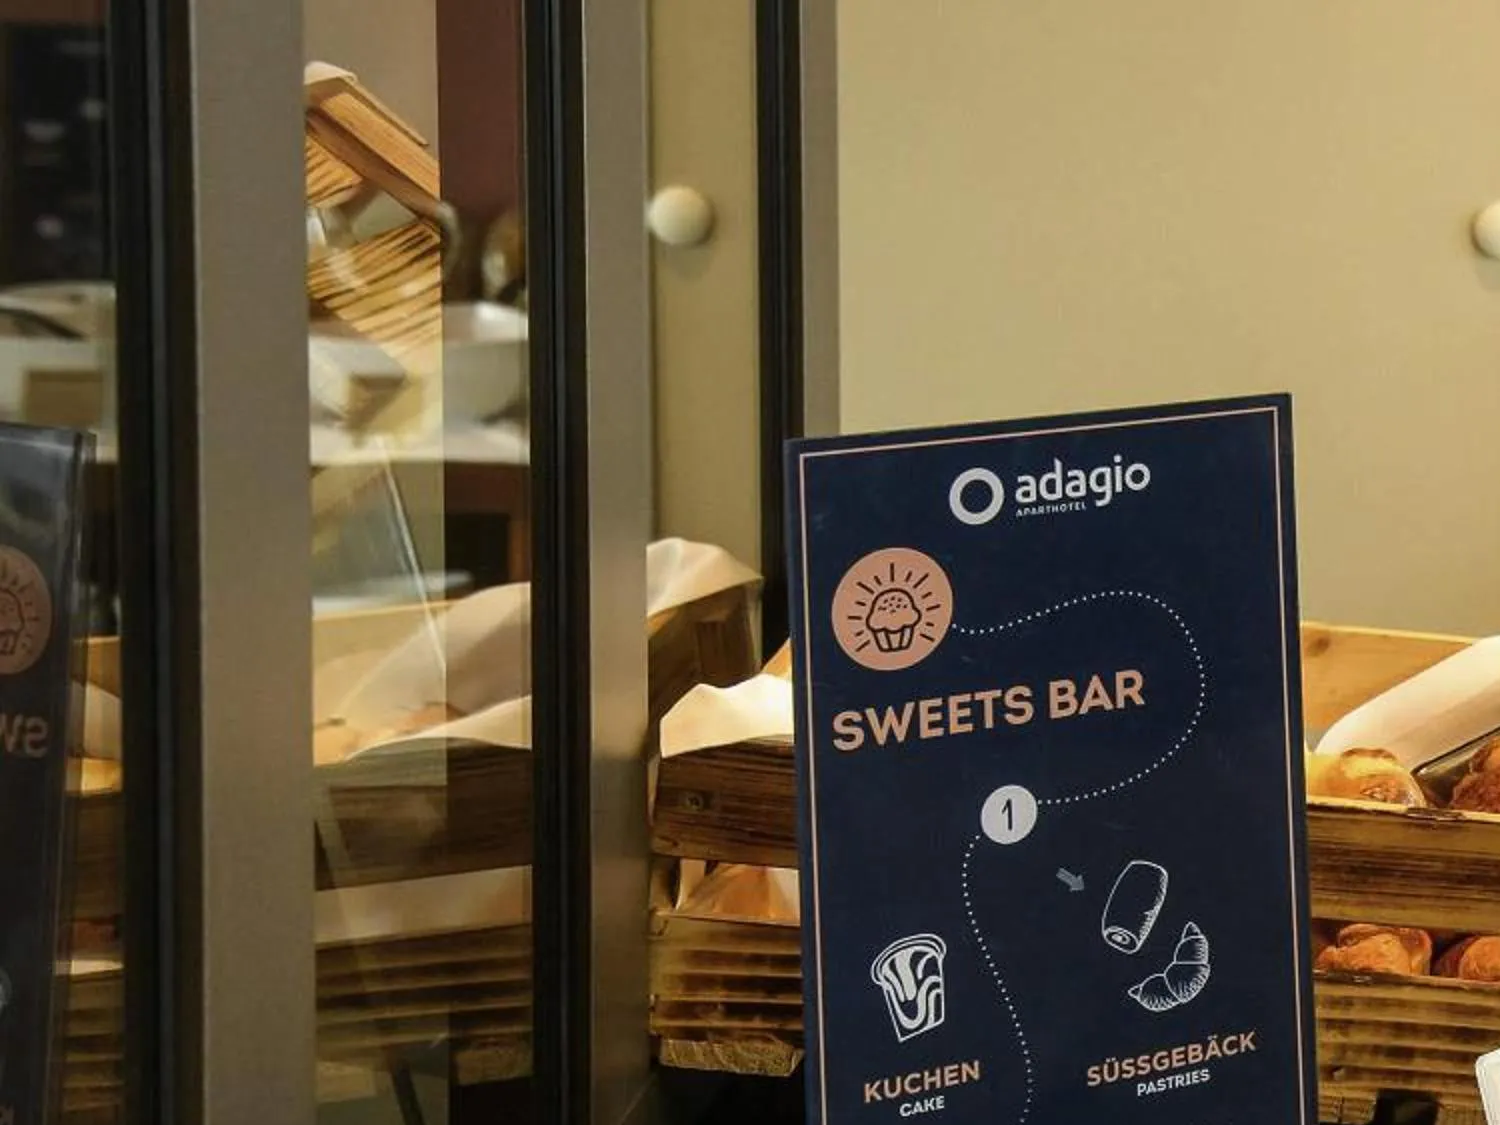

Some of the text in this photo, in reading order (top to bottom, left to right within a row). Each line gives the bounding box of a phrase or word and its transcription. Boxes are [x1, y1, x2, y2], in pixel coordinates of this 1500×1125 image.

[1014, 454, 1151, 507] adagio
[1015, 501, 1088, 517] APARTHOTEL
[831, 669, 1146, 752] SWEETS BAR
[1001, 798, 1013, 832] 1
[1087, 1031, 1257, 1087] SÜSSGEBÄCK
[864, 1060, 981, 1104] KUCHEN
[1136, 1069, 1211, 1097] PASTRIES
[899, 1095, 946, 1117] CAKE
